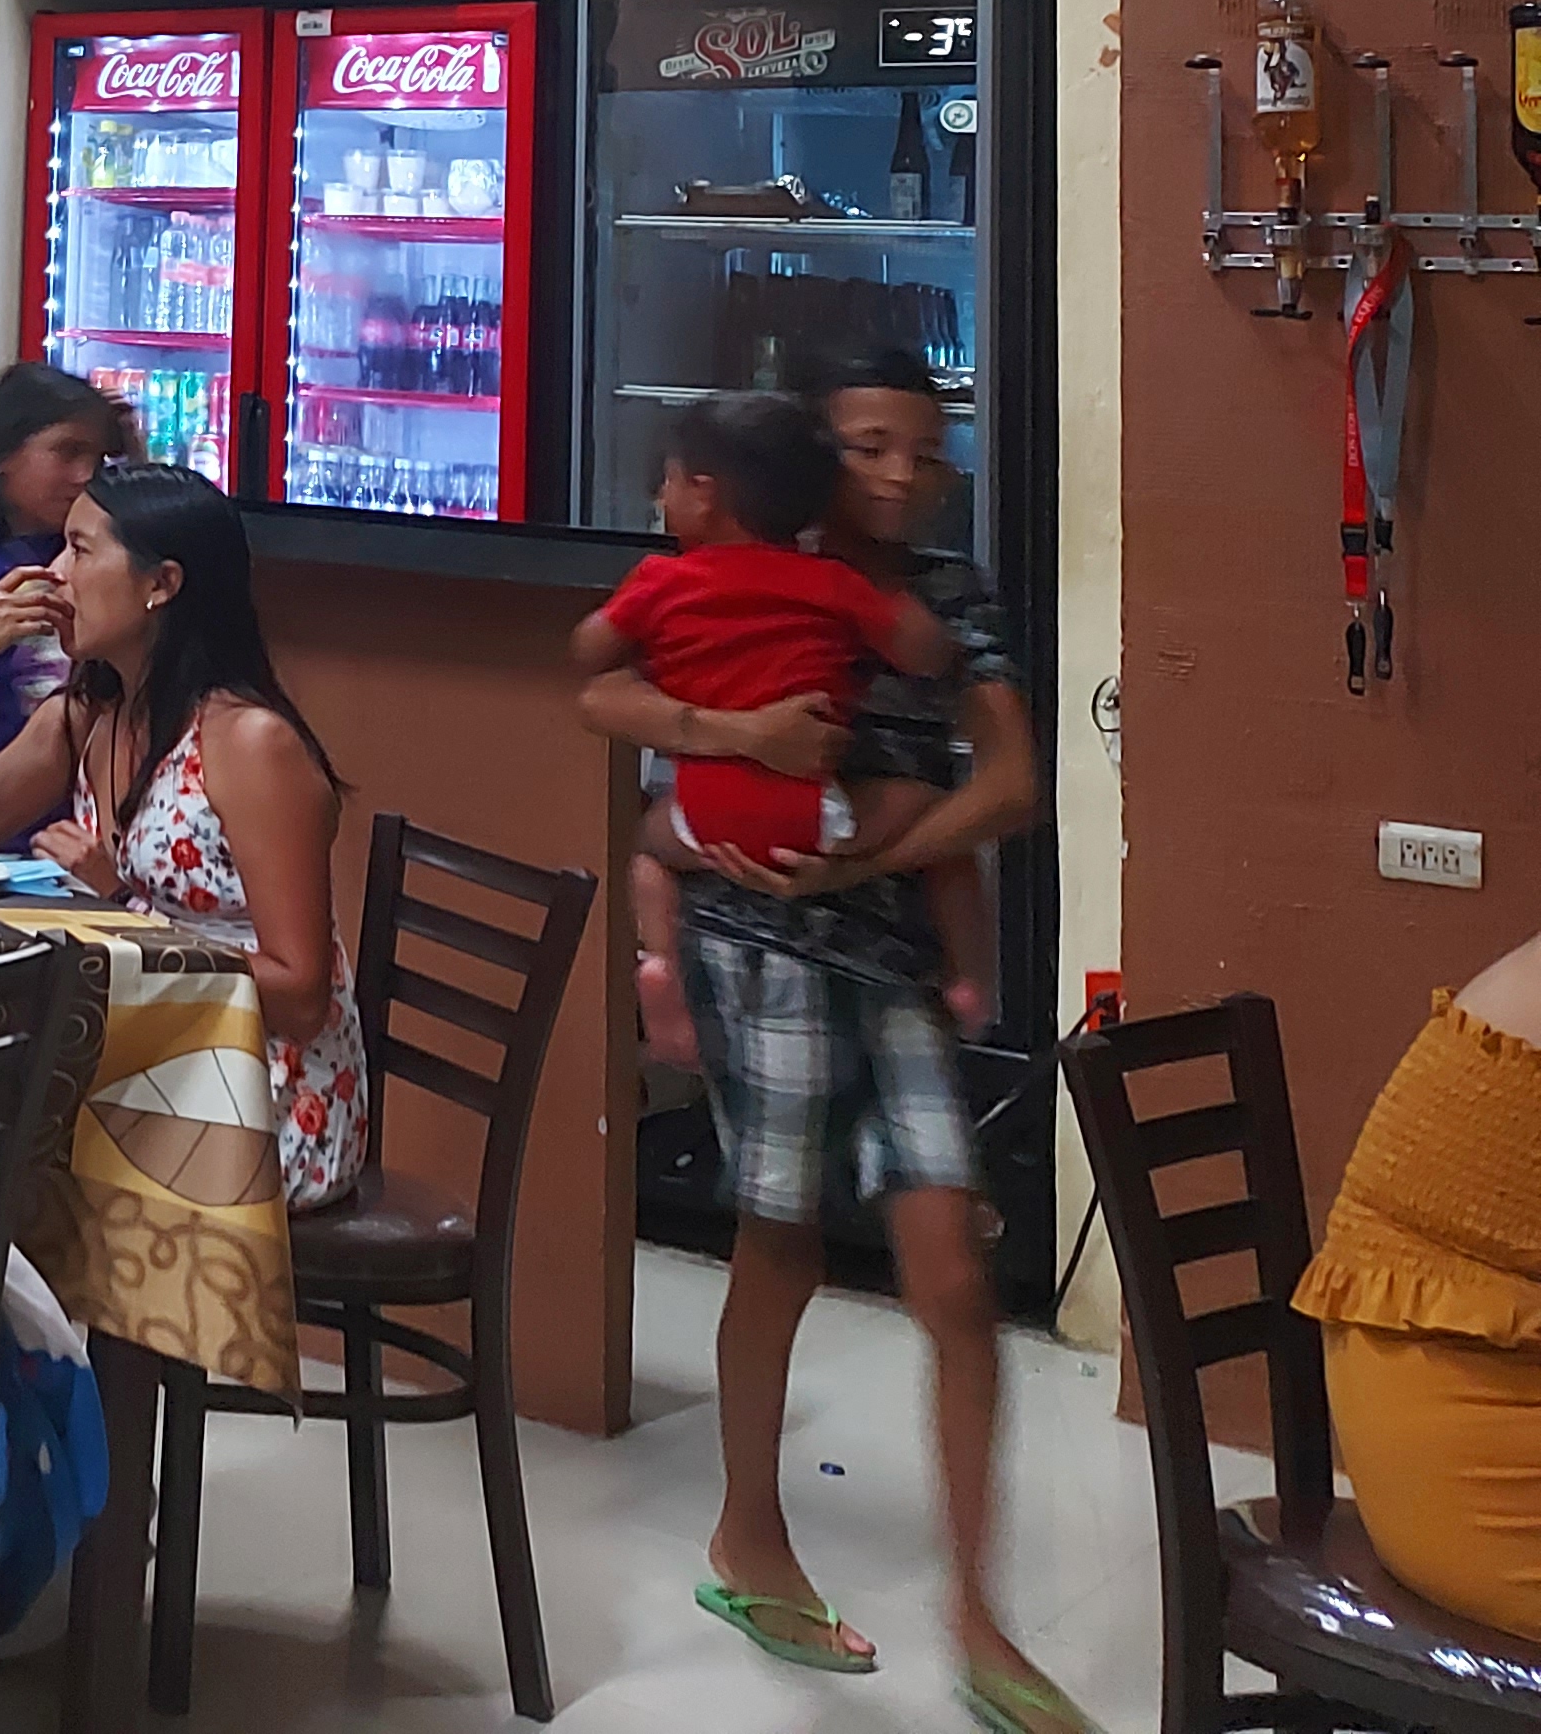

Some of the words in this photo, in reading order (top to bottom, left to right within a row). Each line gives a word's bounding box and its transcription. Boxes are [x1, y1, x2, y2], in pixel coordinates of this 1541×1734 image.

[333, 43, 483, 94] Coca-Cola
[694, 11, 802, 79] SOL
[747, 57, 800, 78] CERVEZA
[97, 51, 228, 98] Coca-Cola
